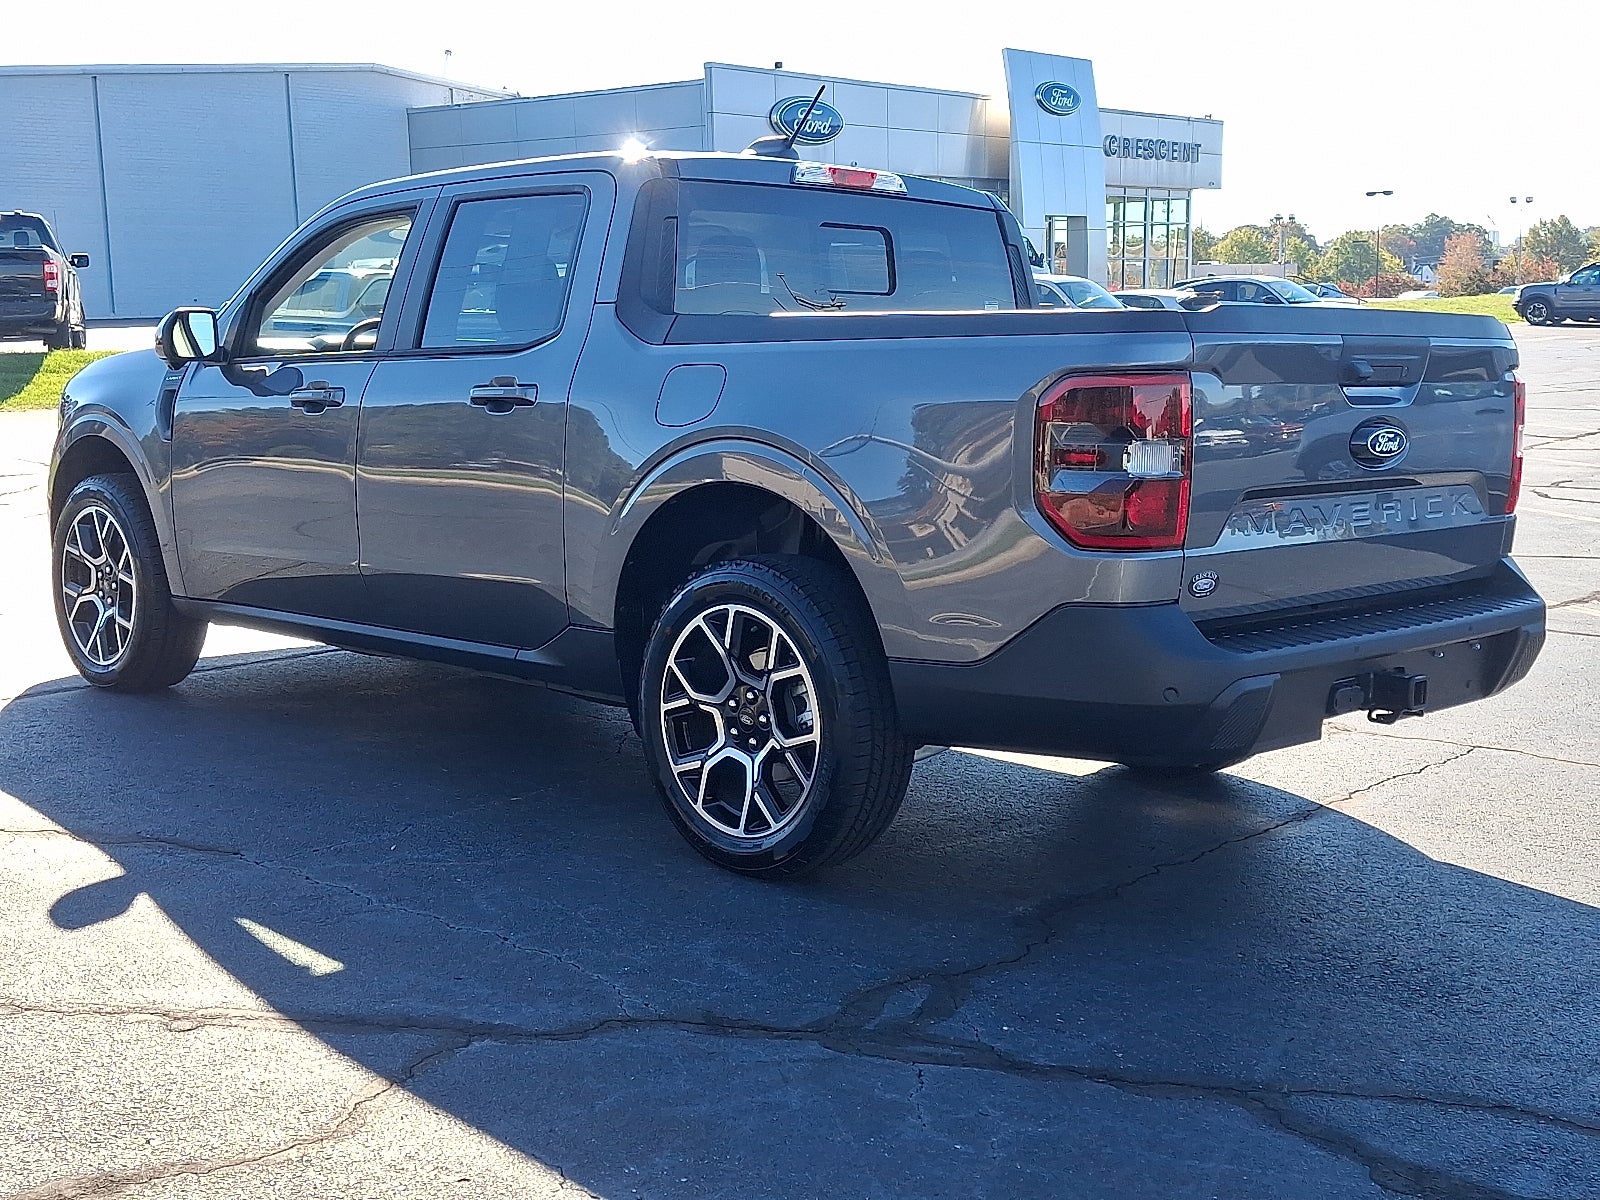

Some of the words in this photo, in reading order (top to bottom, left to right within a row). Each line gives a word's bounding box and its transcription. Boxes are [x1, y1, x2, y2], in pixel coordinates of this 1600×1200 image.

[1050, 88, 1074, 107] Ford
[793, 107, 832, 134] Ford
[1103, 134, 1202, 163] CRESCENT
[1375, 433, 1400, 451] Ford
[1232, 492, 1472, 537] MAVERICK
